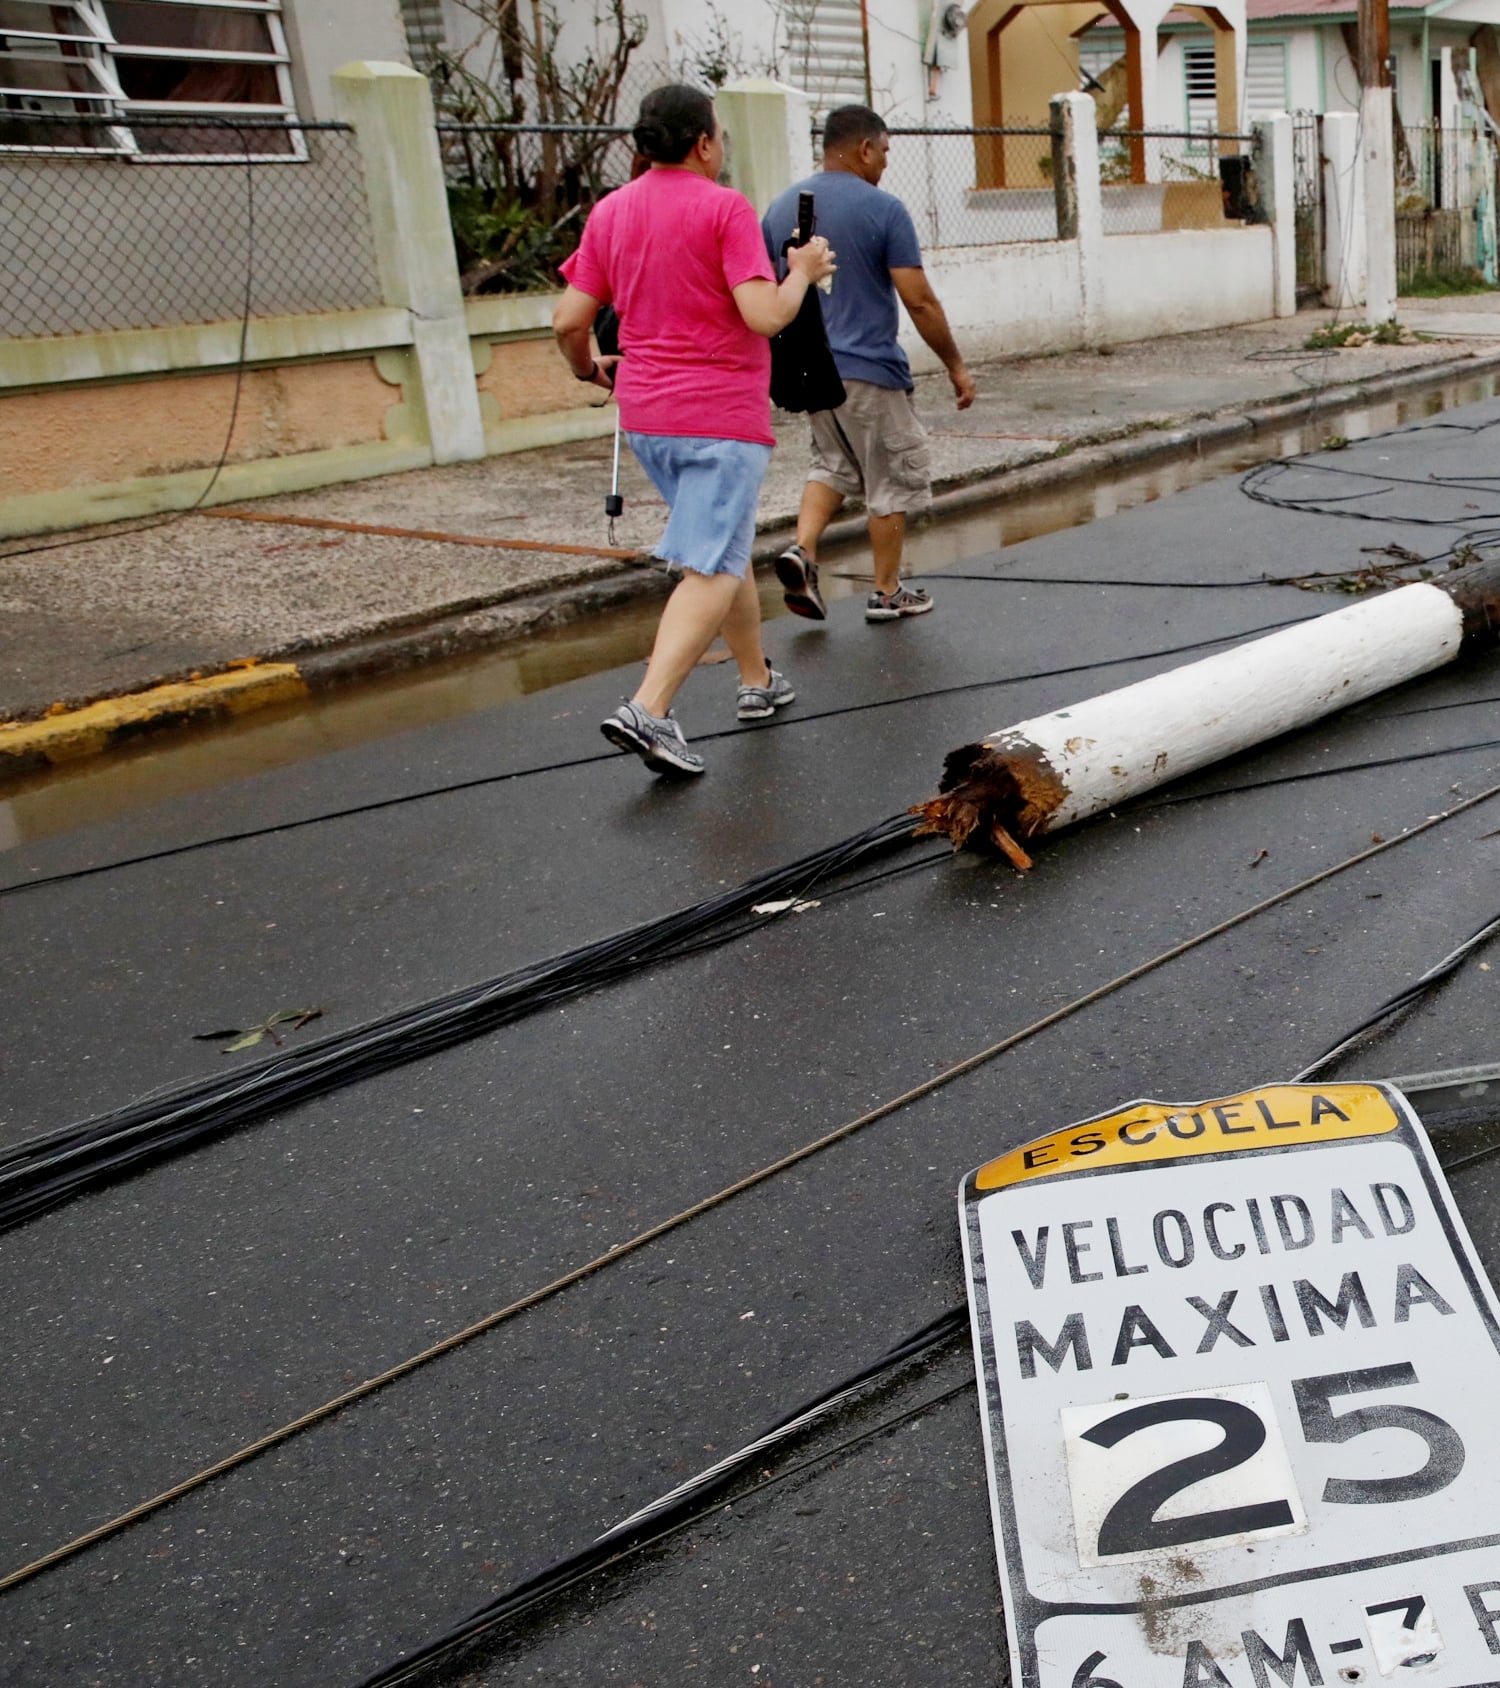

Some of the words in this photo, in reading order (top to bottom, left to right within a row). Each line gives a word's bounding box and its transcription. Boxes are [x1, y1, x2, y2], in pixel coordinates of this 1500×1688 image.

[1023, 1094, 1351, 1170] ESCUELA
[1010, 1181, 1417, 1291] VELOCIDAD
[1013, 1262, 1457, 1380] MAXIMA
[1079, 1361, 1467, 1557] 25
